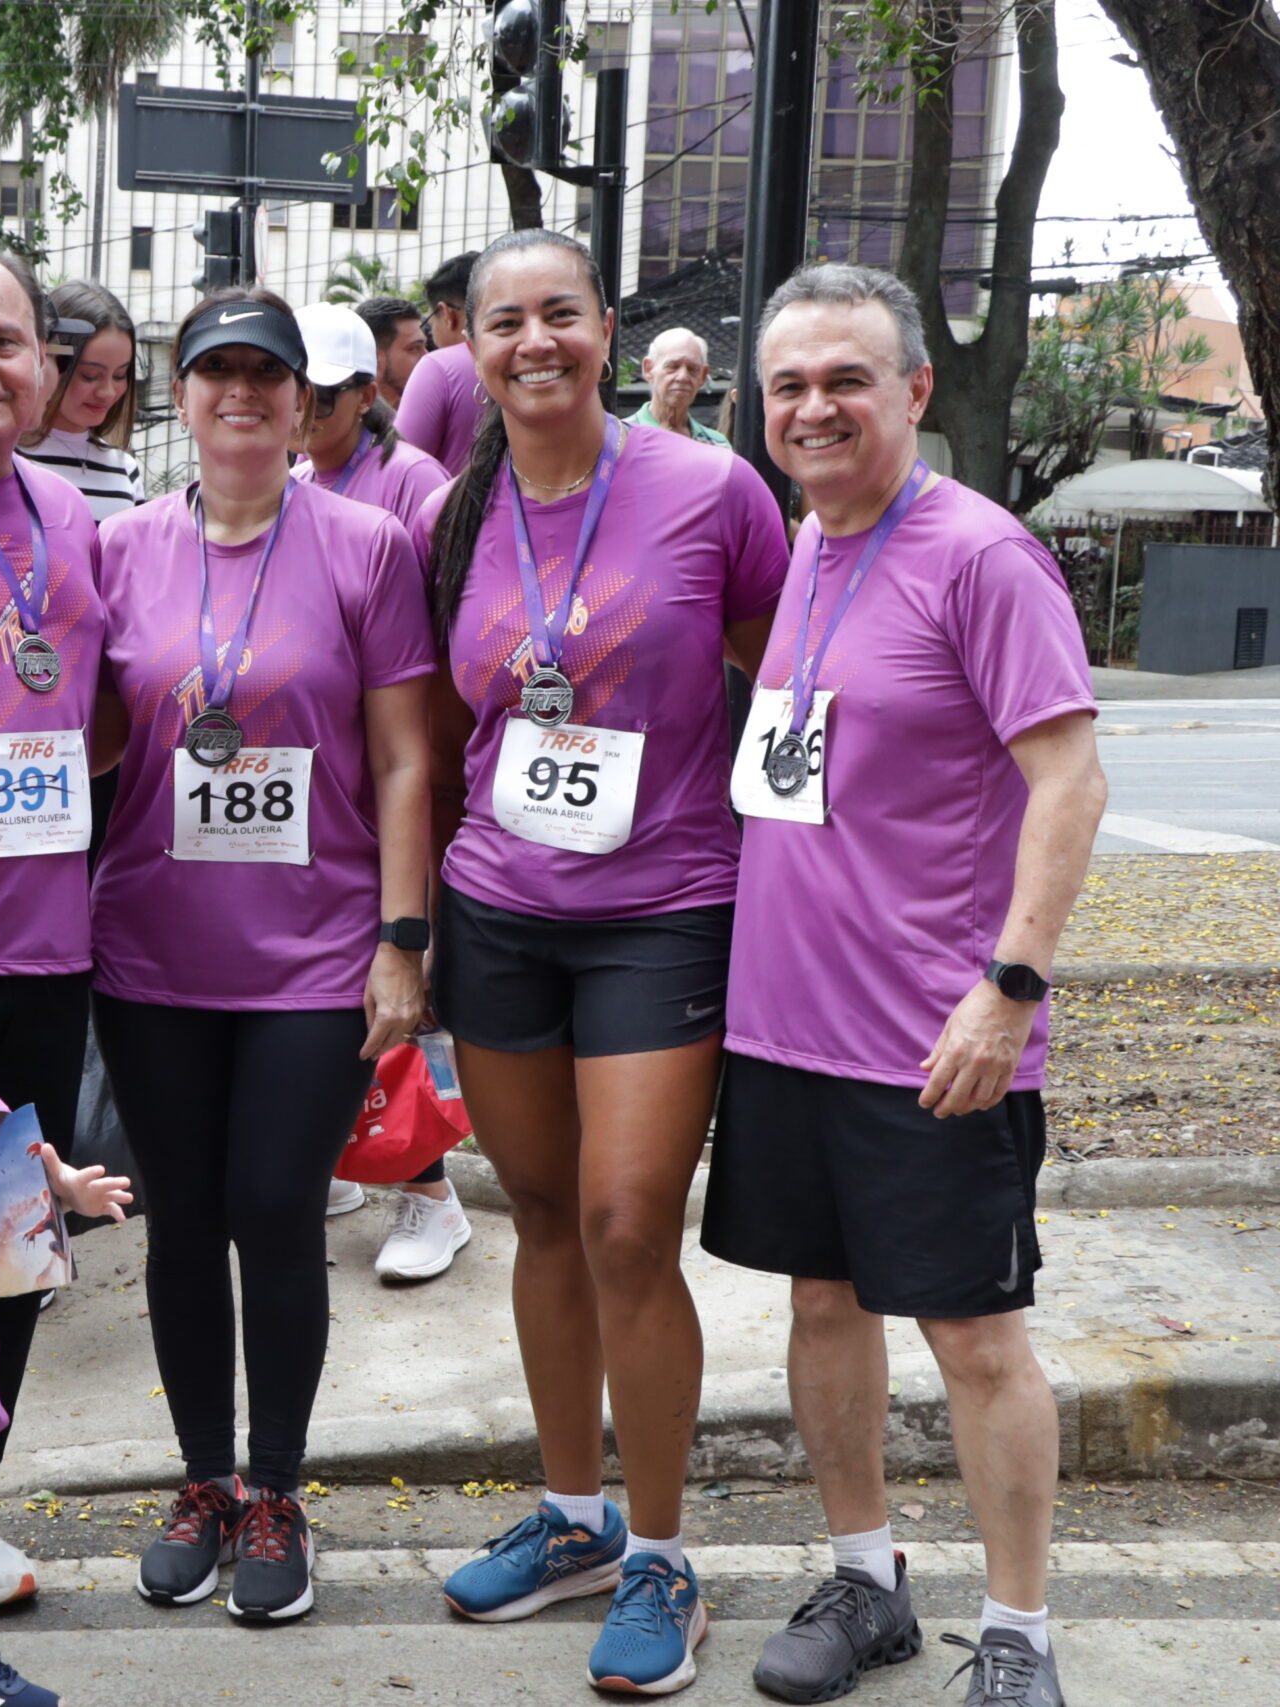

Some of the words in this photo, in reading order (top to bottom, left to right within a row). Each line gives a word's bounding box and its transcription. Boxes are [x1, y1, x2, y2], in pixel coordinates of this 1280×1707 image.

[520, 690, 574, 711] TRF6
[9, 741, 55, 760] TRF6
[184, 730, 243, 753] TRF6
[539, 731, 599, 754] TRF6
[758, 726, 823, 776] 16
[526, 756, 600, 807] 95
[188, 780, 294, 824] 188
[523, 804, 558, 816] KARINA
[560, 809, 593, 821] ABREU
[38, 813, 72, 824] OLIVEIRA
[198, 827, 238, 835] FABIOLA
[240, 826, 282, 835] OLIVEIRA
